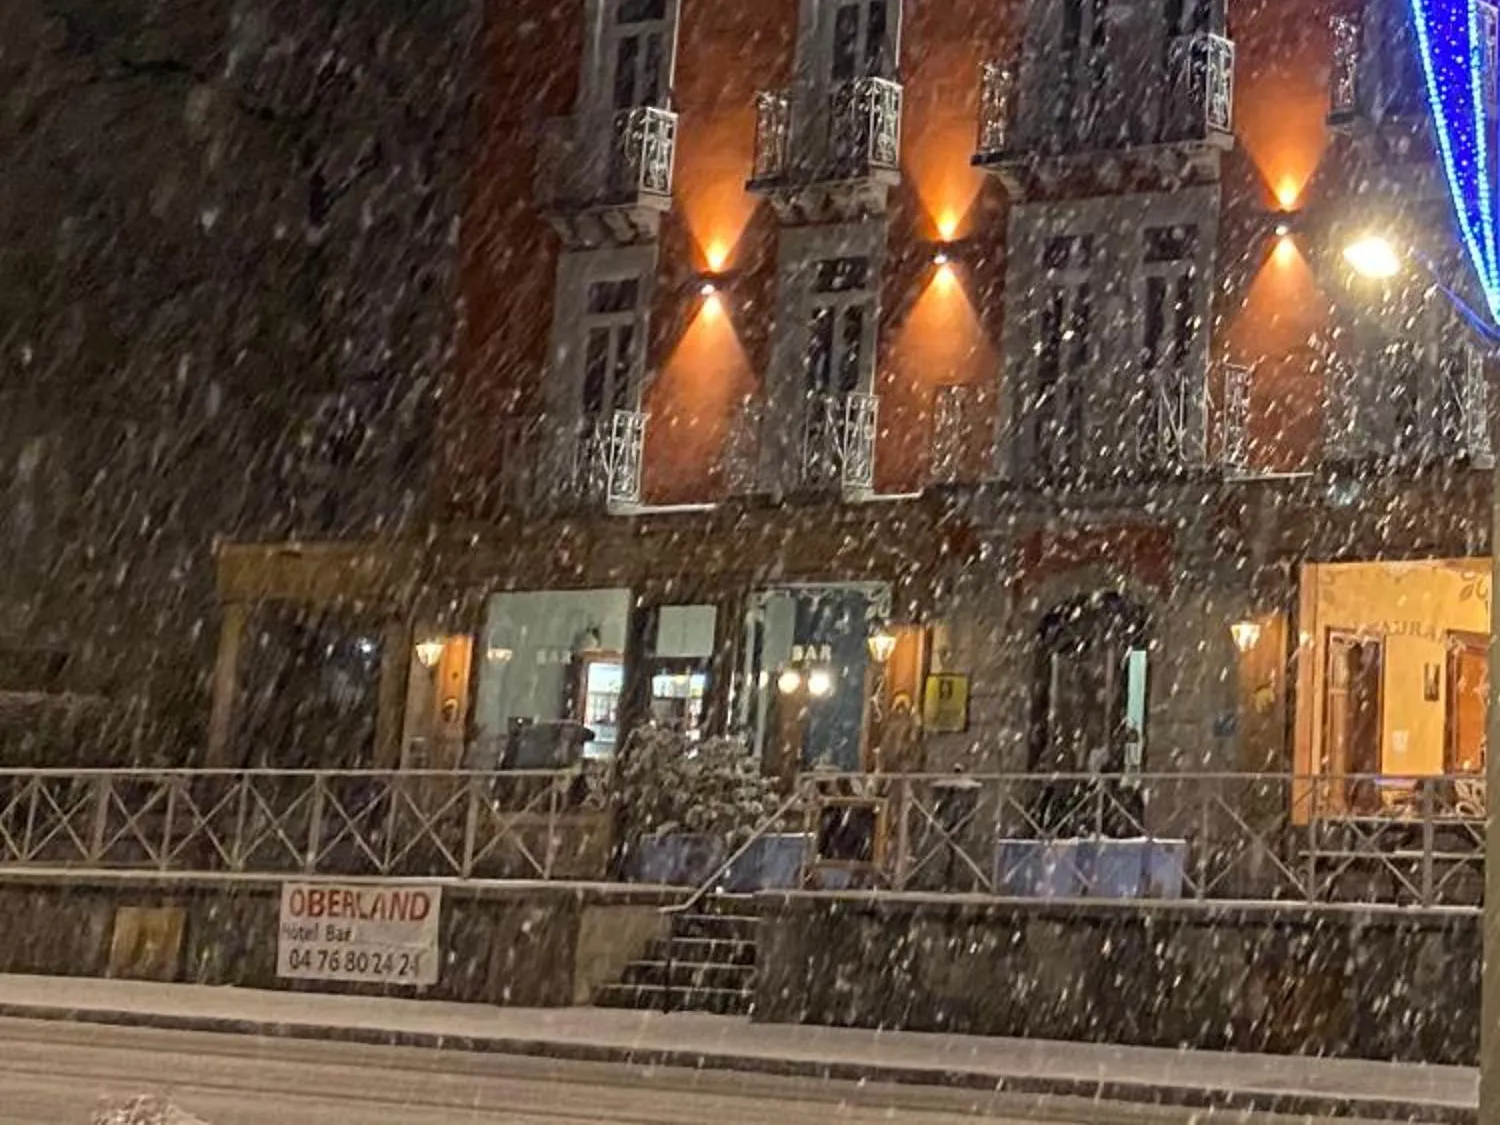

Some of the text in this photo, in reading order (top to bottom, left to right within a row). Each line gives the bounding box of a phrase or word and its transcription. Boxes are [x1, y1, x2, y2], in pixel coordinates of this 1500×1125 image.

[792, 643, 832, 662] BAR
[289, 888, 431, 922] OBERLAND
[325, 923, 352, 942] Bar
[289, 948, 311, 970] 04
[318, 950, 340, 972] 76
[344, 950, 368, 974] 80
[371, 952, 393, 976] 24
